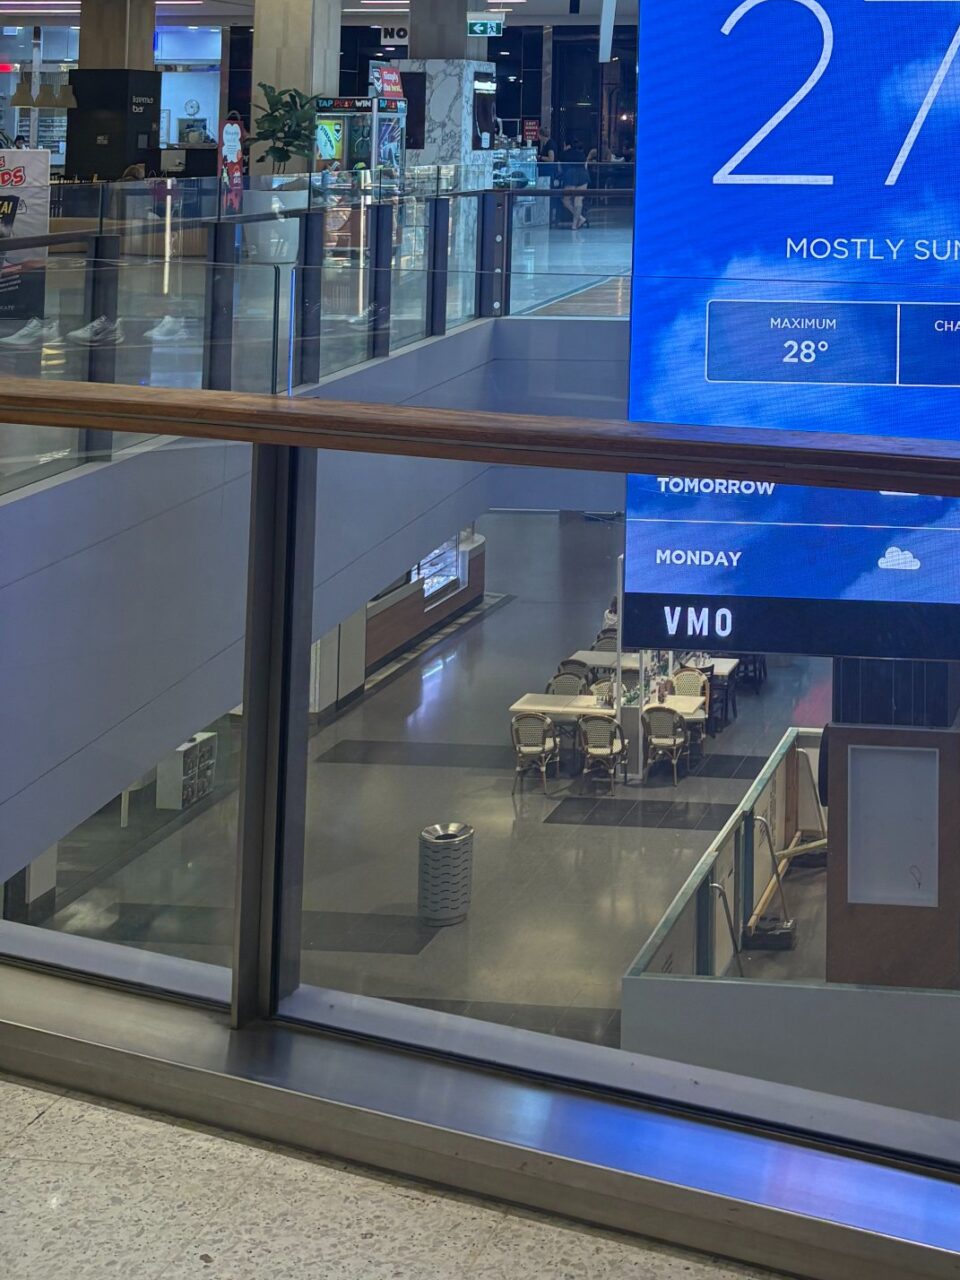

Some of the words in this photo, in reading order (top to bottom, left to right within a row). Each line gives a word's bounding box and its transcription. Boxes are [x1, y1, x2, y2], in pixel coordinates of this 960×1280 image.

[787, 238, 904, 259] MOSTLY
[770, 318, 836, 329] MAXIMUM
[783, 340, 828, 362] 28°
[657, 478, 775, 495] TOMORROW
[656, 550, 741, 566] MONDAY
[664, 607, 732, 636] VMO
